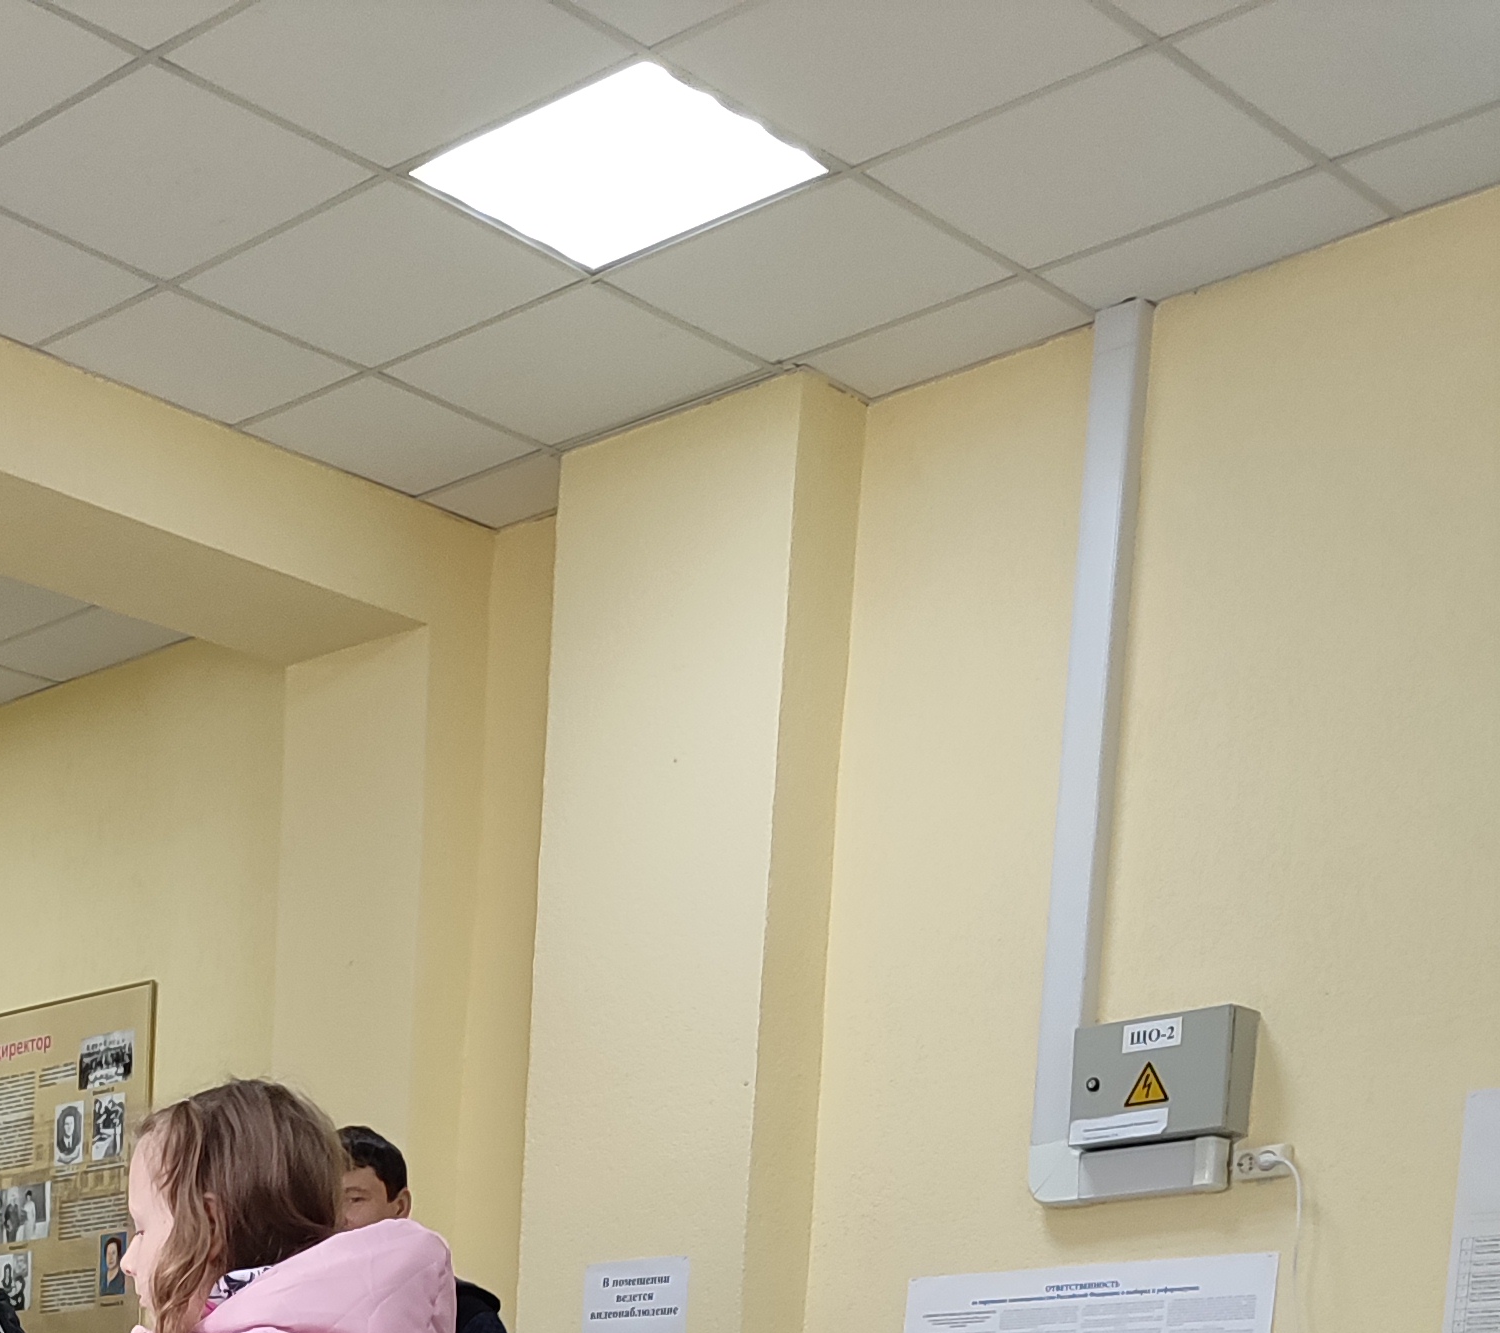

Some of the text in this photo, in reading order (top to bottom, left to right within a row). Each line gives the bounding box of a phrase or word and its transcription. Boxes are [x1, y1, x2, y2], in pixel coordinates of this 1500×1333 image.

[1130, 1026, 1175, 1045] ЩО-2
[603, 1277, 610, 1288] В
[616, 1292, 654, 1303] ведется
[590, 1306, 679, 1320] видеонаблюдение
